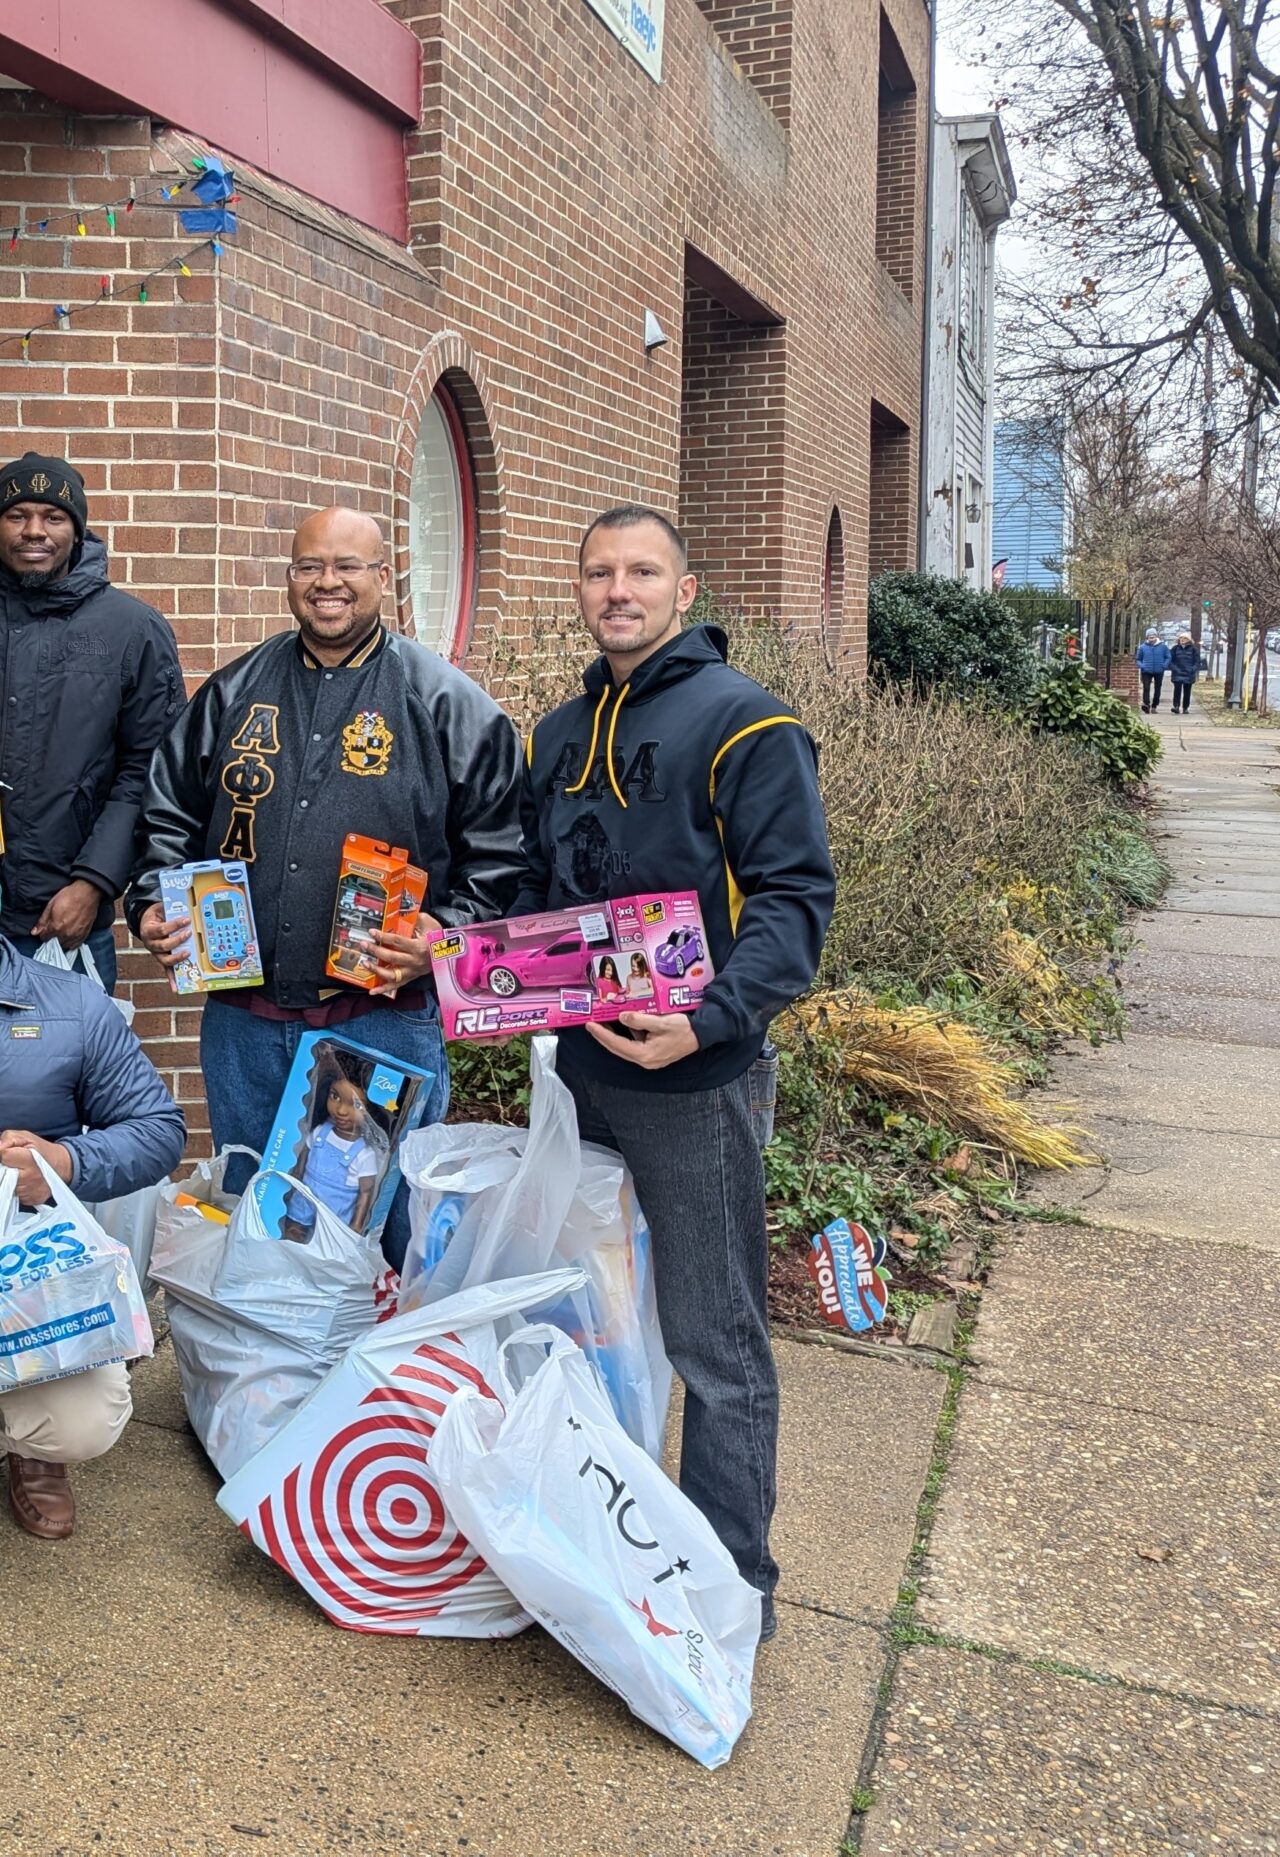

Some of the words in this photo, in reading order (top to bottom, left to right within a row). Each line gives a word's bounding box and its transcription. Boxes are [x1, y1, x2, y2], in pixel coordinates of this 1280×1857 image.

[433, 940, 448, 952] NEW
[433, 946, 461, 959] BRIGHT
[455, 1007, 501, 1035] RC
[500, 1021, 529, 1030] Decorator
[374, 1075, 398, 1092] Zoe
[274, 1128, 287, 1148] CARE
[20, 1267, 52, 1287] FOR
[56, 1254, 94, 1273] LESS
[851, 1243, 874, 1287] WE
[815, 1251, 841, 1314] YOU!
